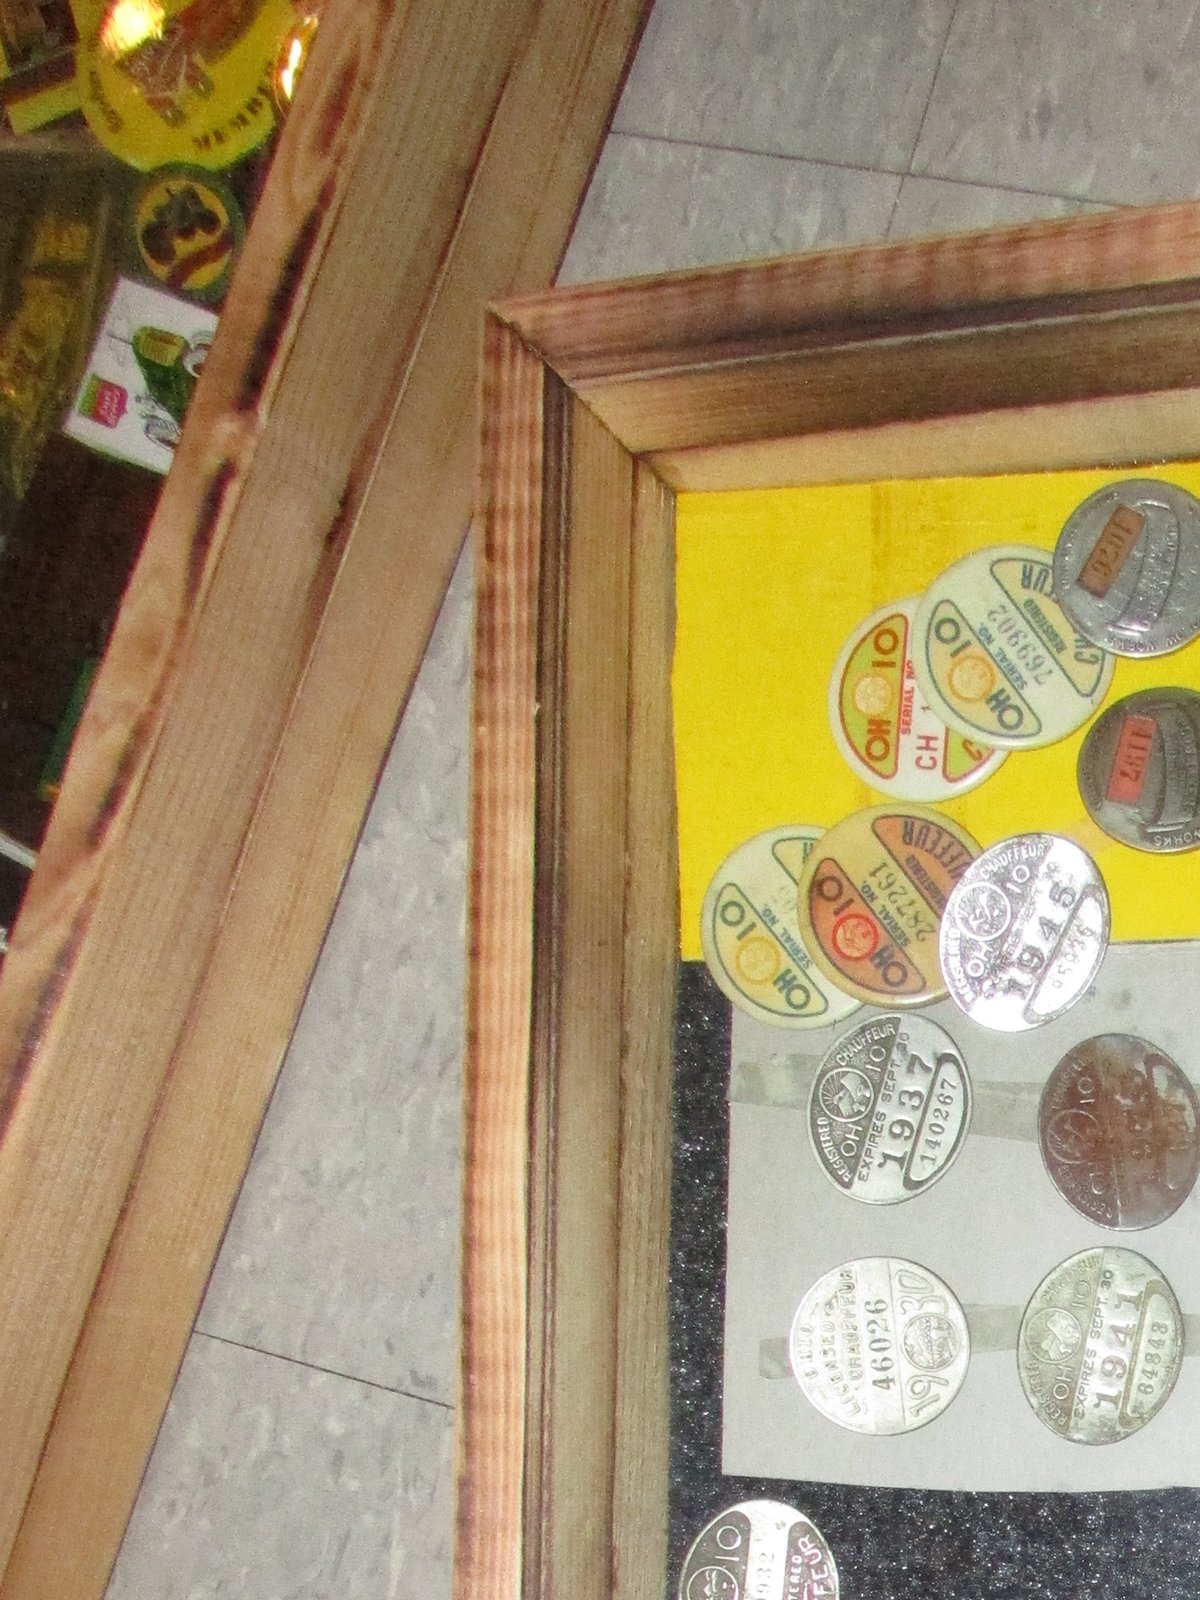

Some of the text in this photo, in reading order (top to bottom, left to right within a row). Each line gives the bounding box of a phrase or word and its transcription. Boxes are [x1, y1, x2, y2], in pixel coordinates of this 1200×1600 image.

[987, 603, 1053, 686] 769902
[1023, 599, 1067, 653] REGISTERED
[992, 647, 1028, 690] SERIAL
[900, 687, 914, 735] SERIAL
[916, 735, 939, 770] CH
[979, 839, 1048, 879] CHAUFFEUR
[868, 862, 936, 942] 287261
[878, 905, 911, 946] SERIAL
[1005, 882, 1077, 998] 1945
[782, 928, 813, 969] SERIAL
[817, 1022, 895, 1182] REGISTERED CHAUFFEUR
[877, 1053, 932, 1171] 1937
[920, 1078, 957, 1165] 140267
[858, 1111, 886, 1182] EXPIRES
[822, 1321, 860, 1415] LICENSED
[864, 1299, 896, 1390] 46026
[1074, 1270, 1113, 1419] EXPIRES 30
[1093, 1290, 1143, 1409] 1941
[1027, 1360, 1067, 1425] REGISTERED
